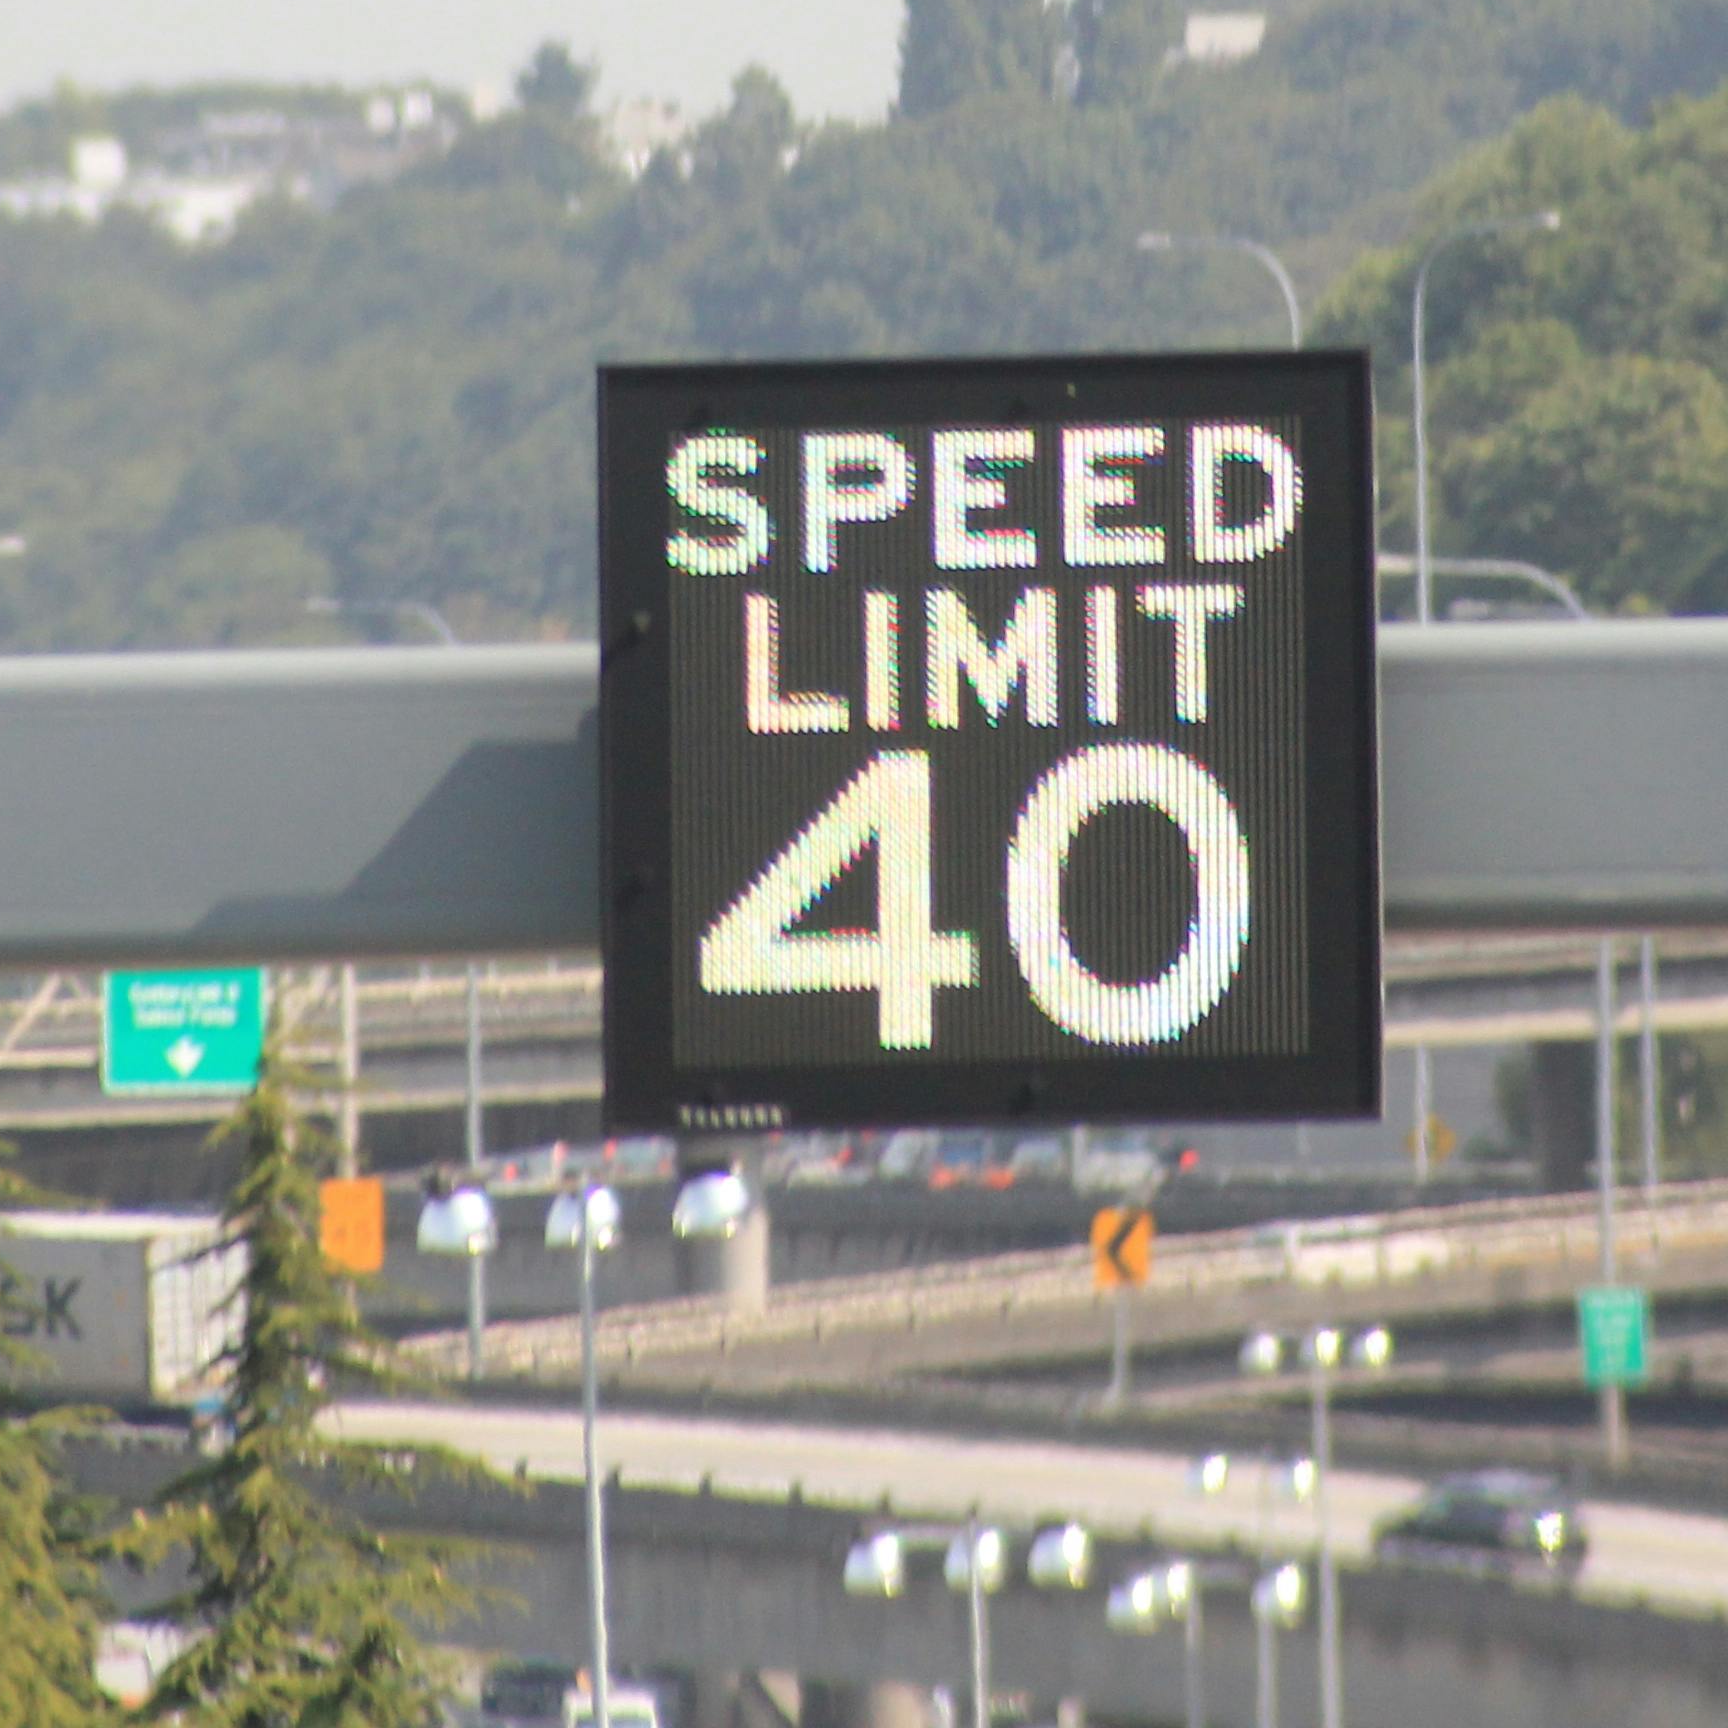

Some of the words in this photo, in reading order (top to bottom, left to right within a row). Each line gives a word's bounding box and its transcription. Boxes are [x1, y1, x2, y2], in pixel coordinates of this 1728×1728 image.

[666, 425, 1303, 576] SPEED
[745, 585, 1245, 734] LIMIT
[700, 742, 1250, 1051] 40
